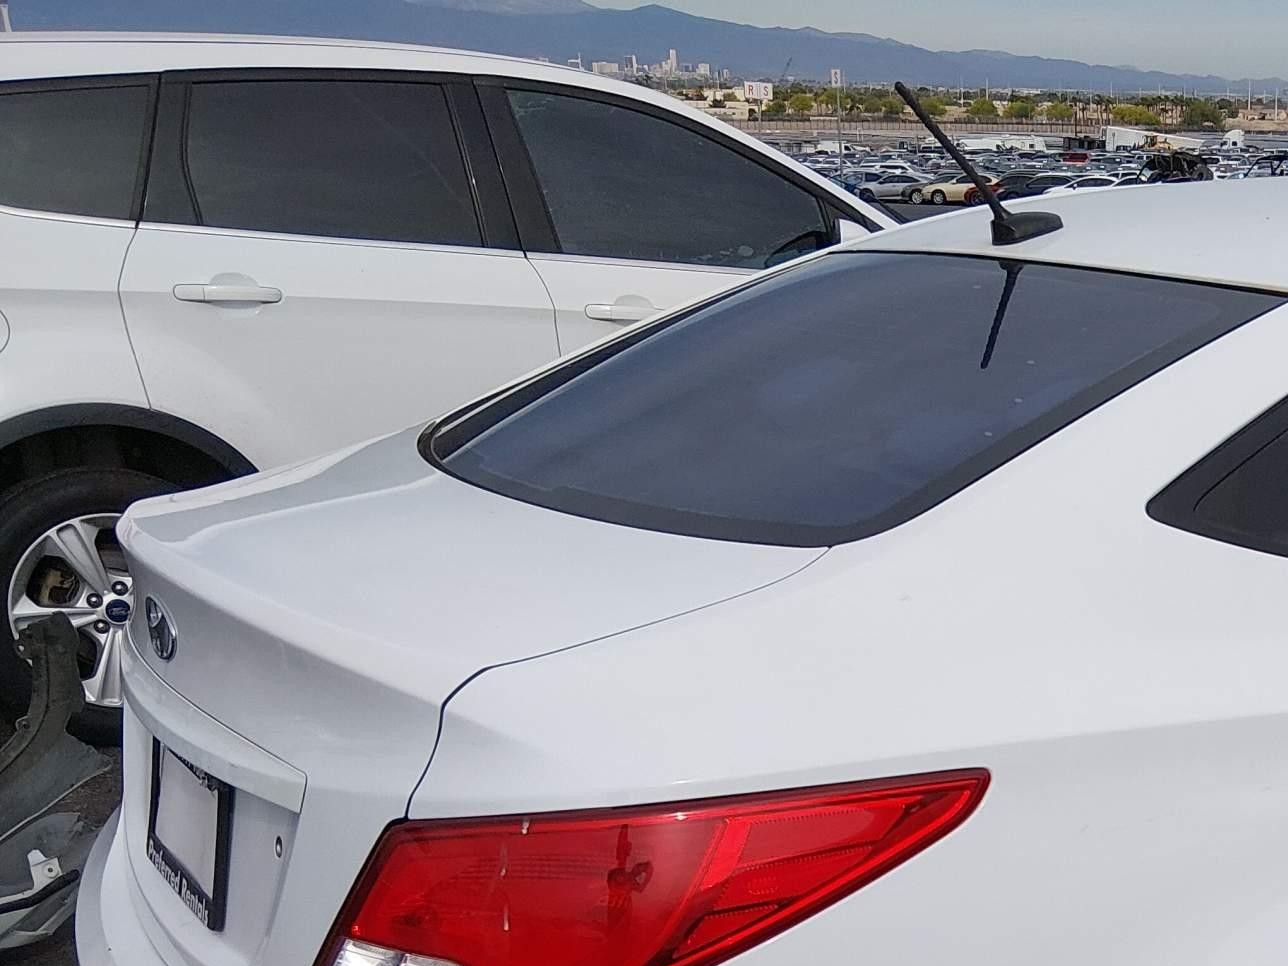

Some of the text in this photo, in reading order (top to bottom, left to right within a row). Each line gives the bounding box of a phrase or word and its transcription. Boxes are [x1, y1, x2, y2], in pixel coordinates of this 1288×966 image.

[748, 84, 754, 94] R
[763, 86, 769, 97] S
[149, 838, 209, 926] Preferred Rentals
